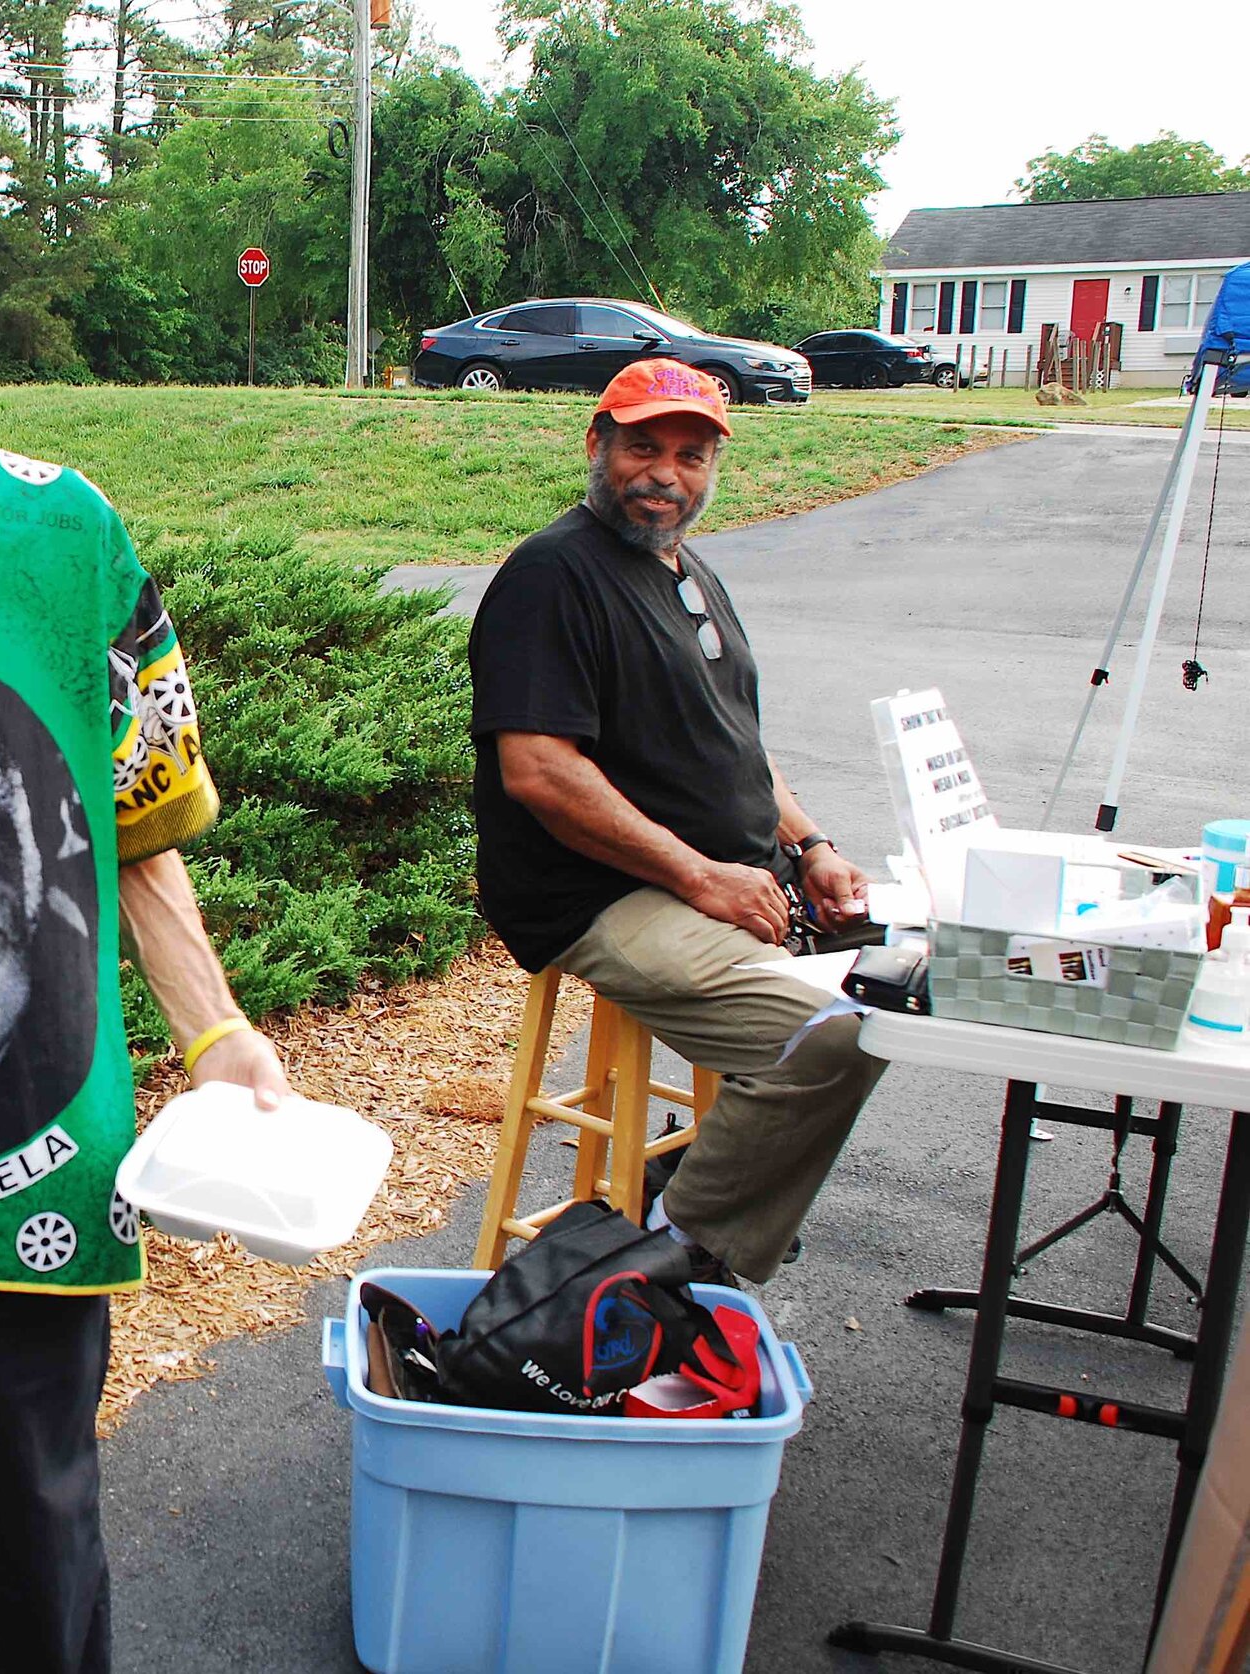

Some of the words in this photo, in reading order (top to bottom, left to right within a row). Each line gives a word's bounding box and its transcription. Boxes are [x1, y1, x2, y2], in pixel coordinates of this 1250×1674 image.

[240, 260, 267, 275] STOP
[521, 1359, 551, 1387] We
[550, 1383, 591, 1409] Love
